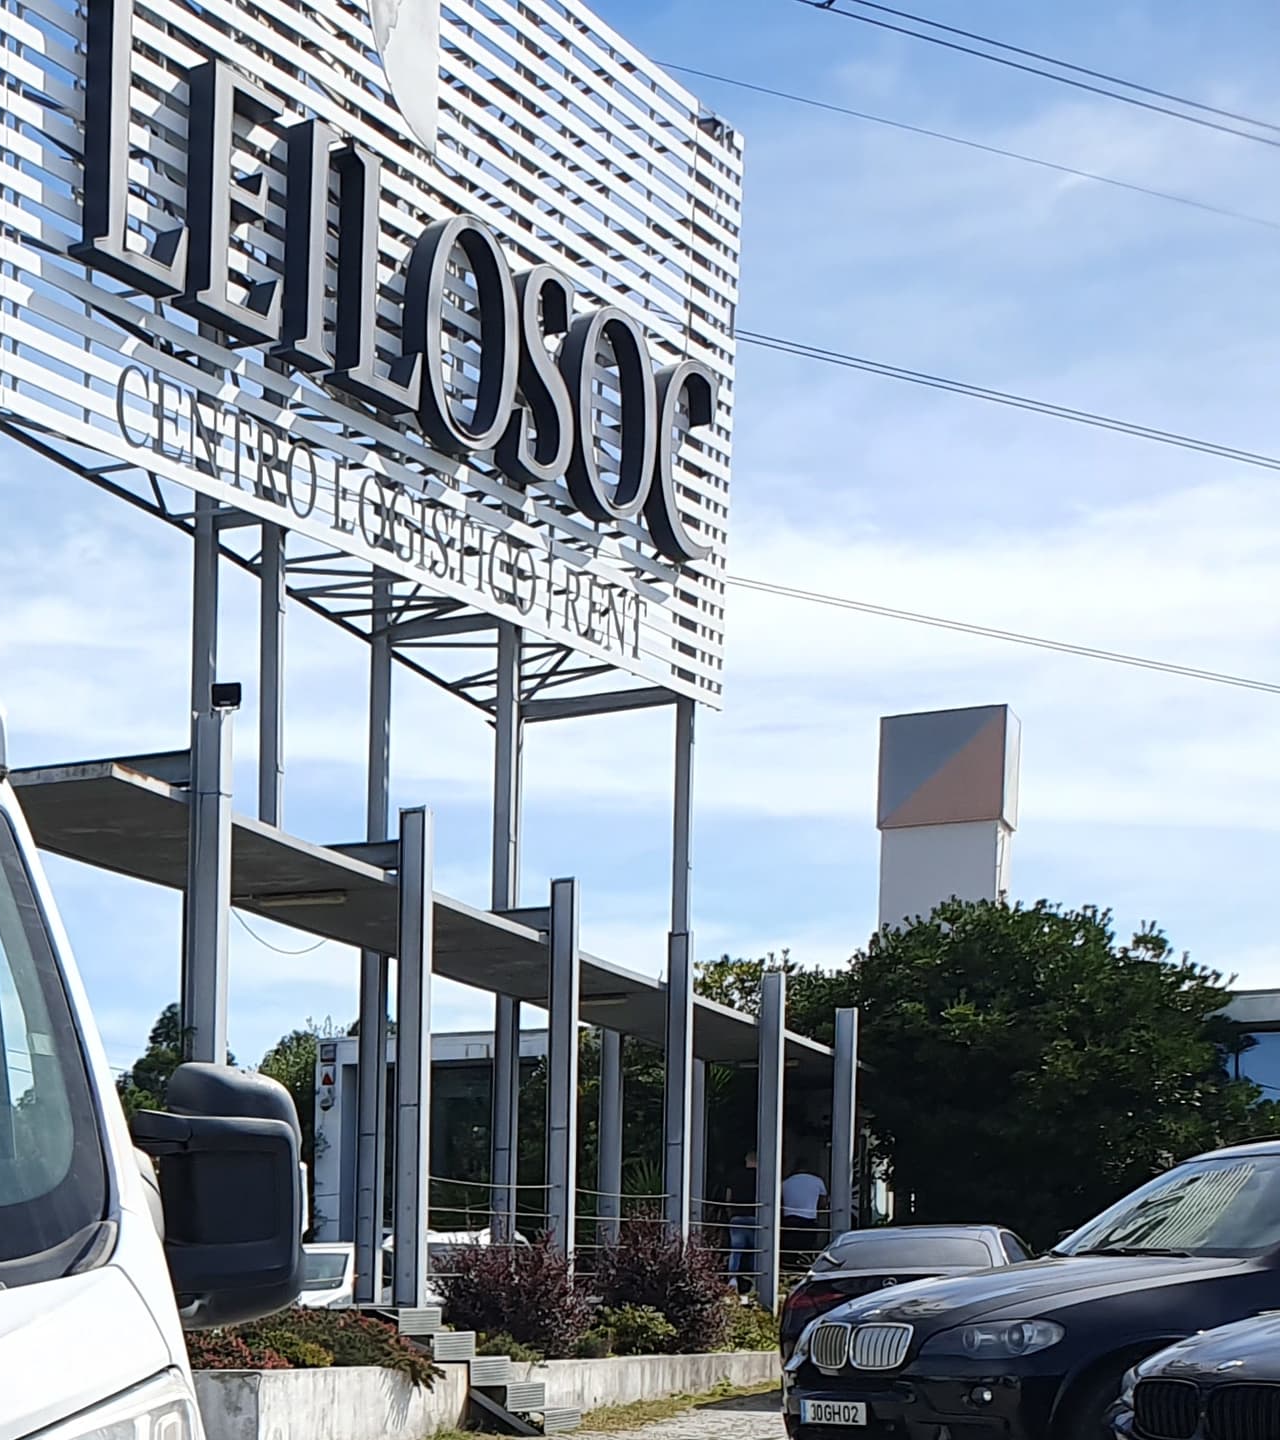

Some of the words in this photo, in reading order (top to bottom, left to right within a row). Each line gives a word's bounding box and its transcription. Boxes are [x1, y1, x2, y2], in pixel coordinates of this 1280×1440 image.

[68, 0, 719, 563] LEILOSOC
[116, 364, 317, 519] CENTRO
[561, 566, 648, 661] RENT
